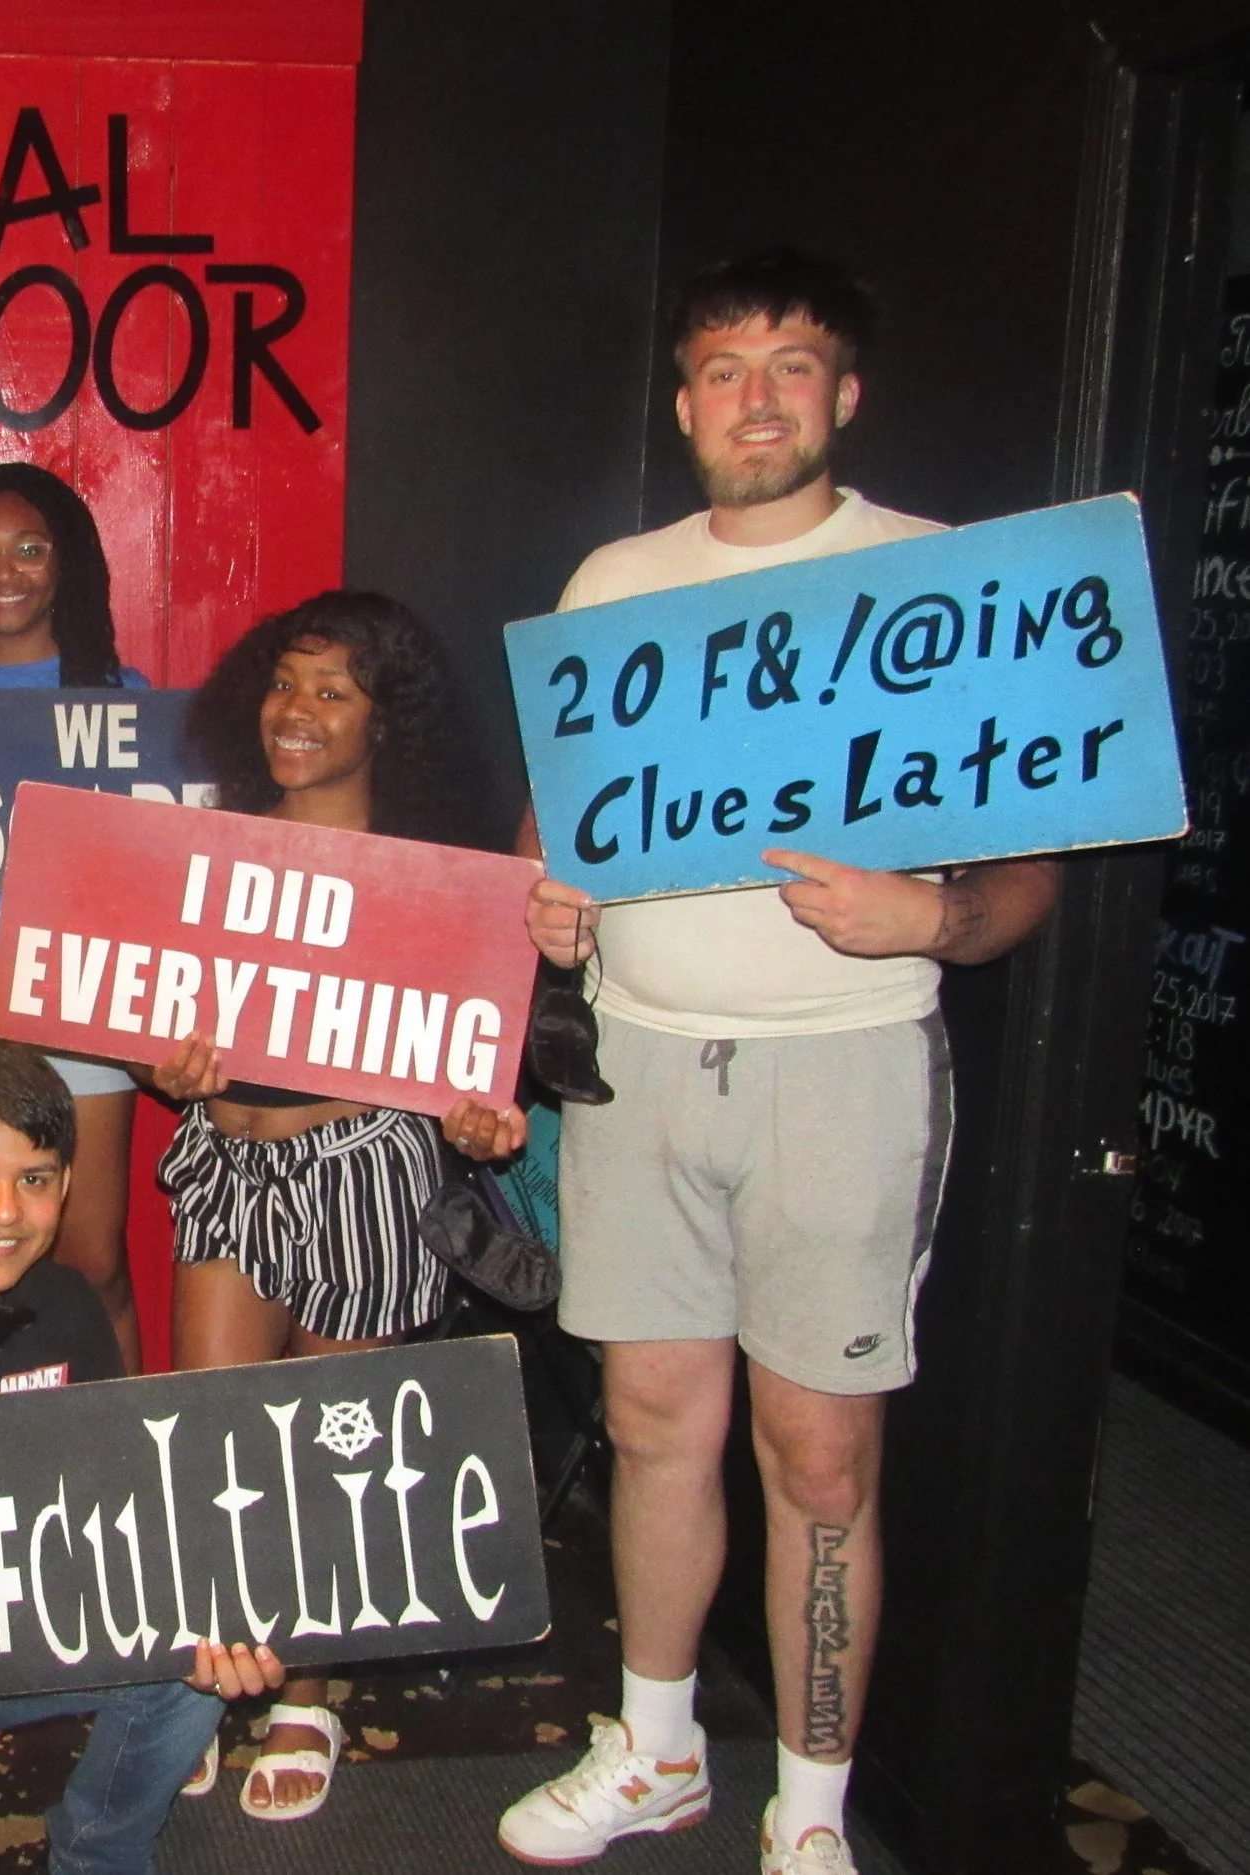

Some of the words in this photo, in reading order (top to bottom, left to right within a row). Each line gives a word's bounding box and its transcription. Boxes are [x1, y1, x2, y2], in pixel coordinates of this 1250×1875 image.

[53, 703, 140, 769] WE
[548, 641, 664, 738] 20
[573, 763, 816, 865] Clues
[842, 716, 1124, 826] Later
[180, 853, 211, 925] I
[223, 860, 356, 948] DID
[8, 925, 502, 1094] EVERYTHING
[806, 1521, 851, 1756] FEARLESS
